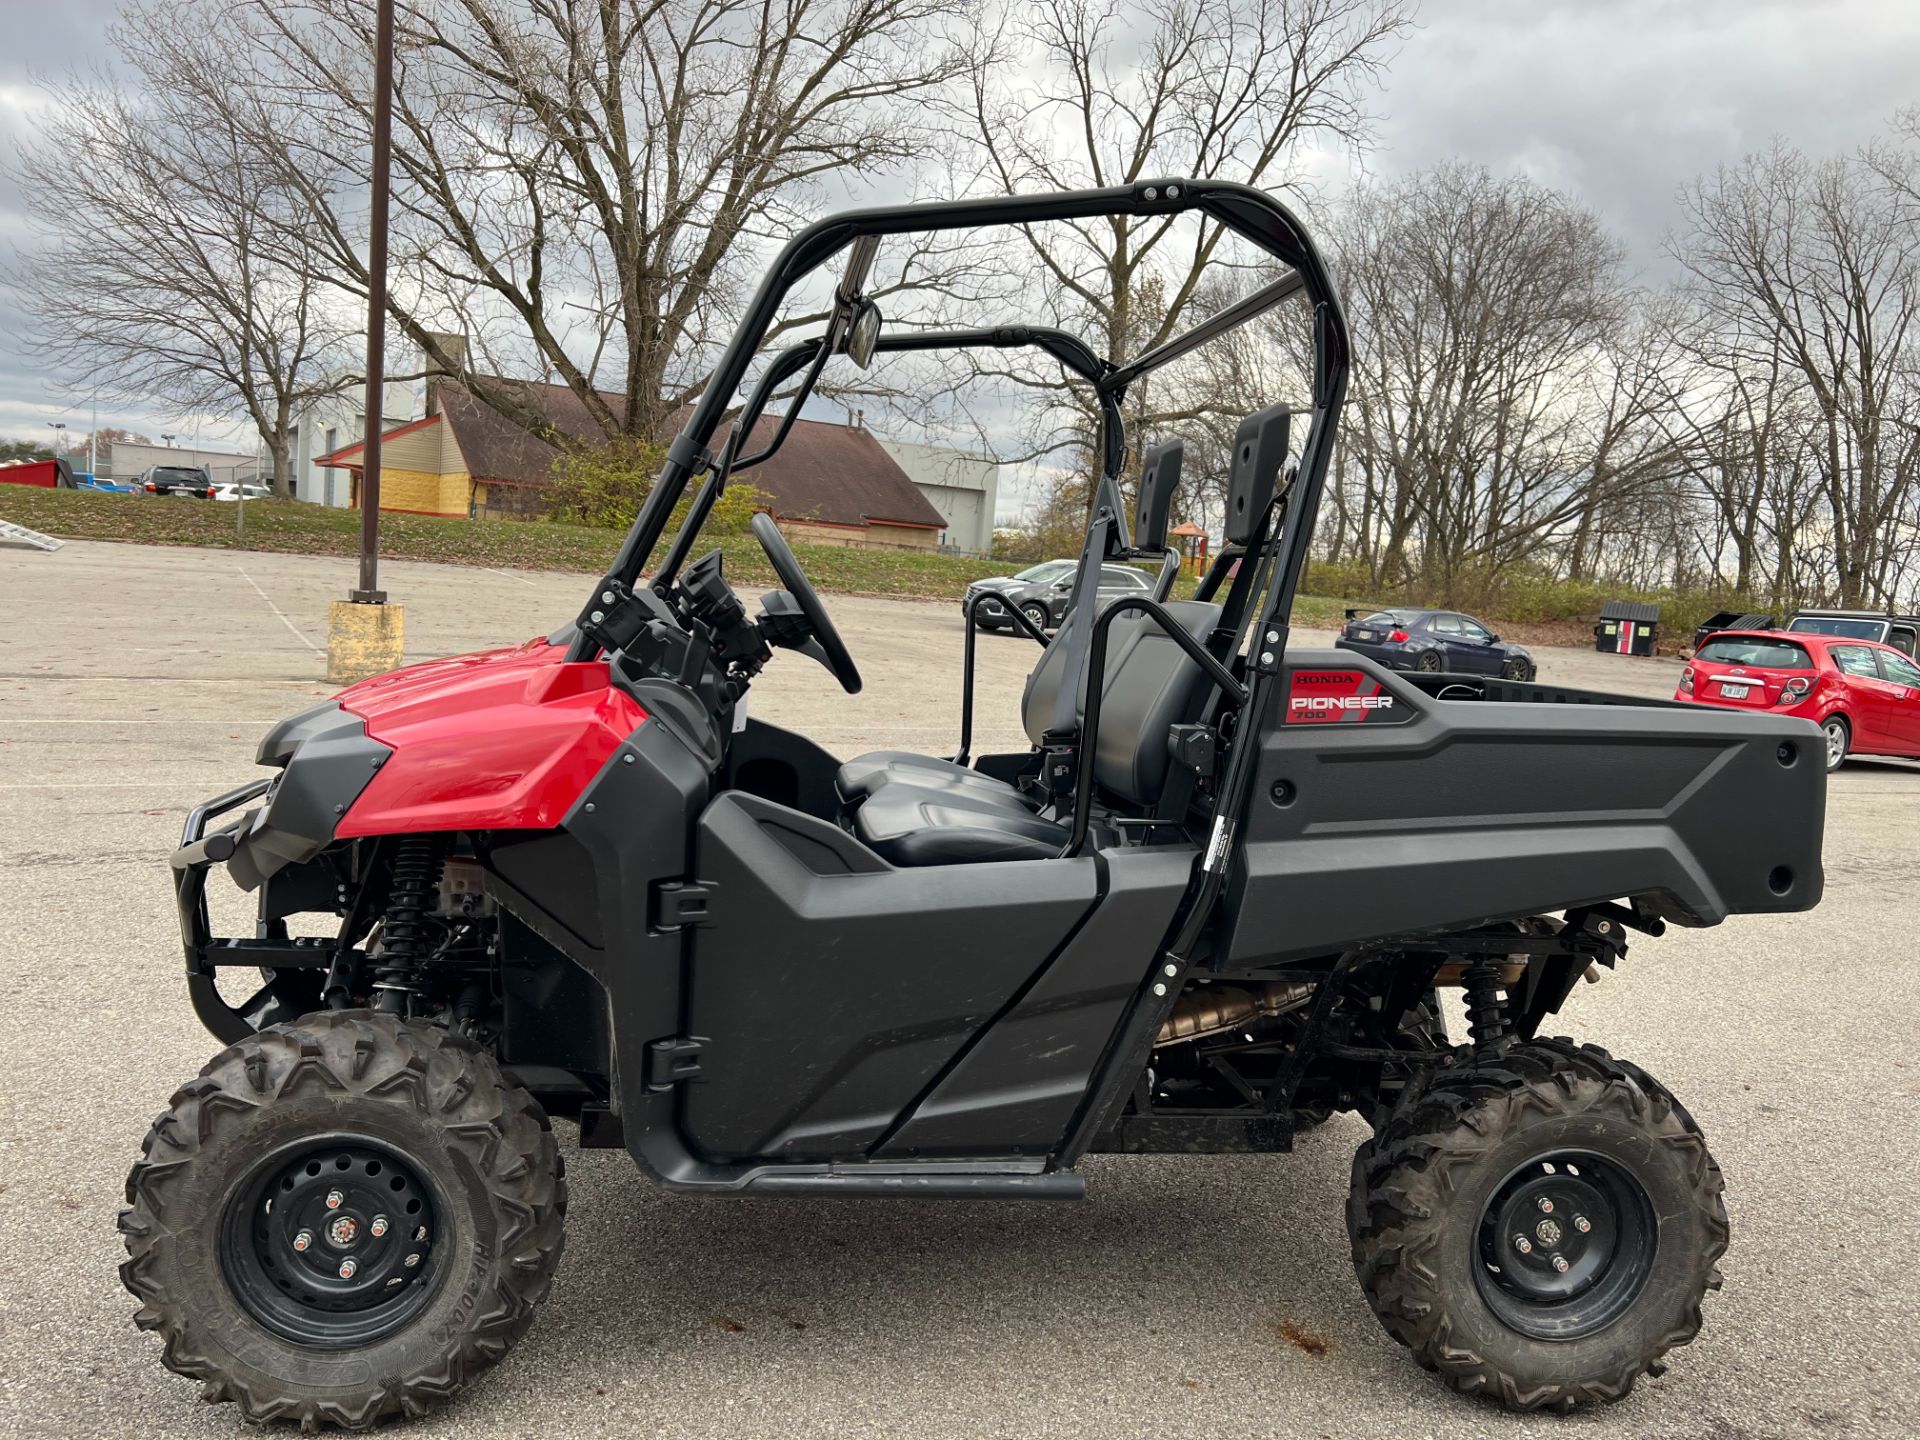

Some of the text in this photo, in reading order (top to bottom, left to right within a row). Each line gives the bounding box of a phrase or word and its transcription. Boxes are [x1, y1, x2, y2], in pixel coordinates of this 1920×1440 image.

[1296, 675, 1355, 685] HONDA
[1291, 696, 1393, 710] PIONEER
[1294, 711, 1327, 719] 700
